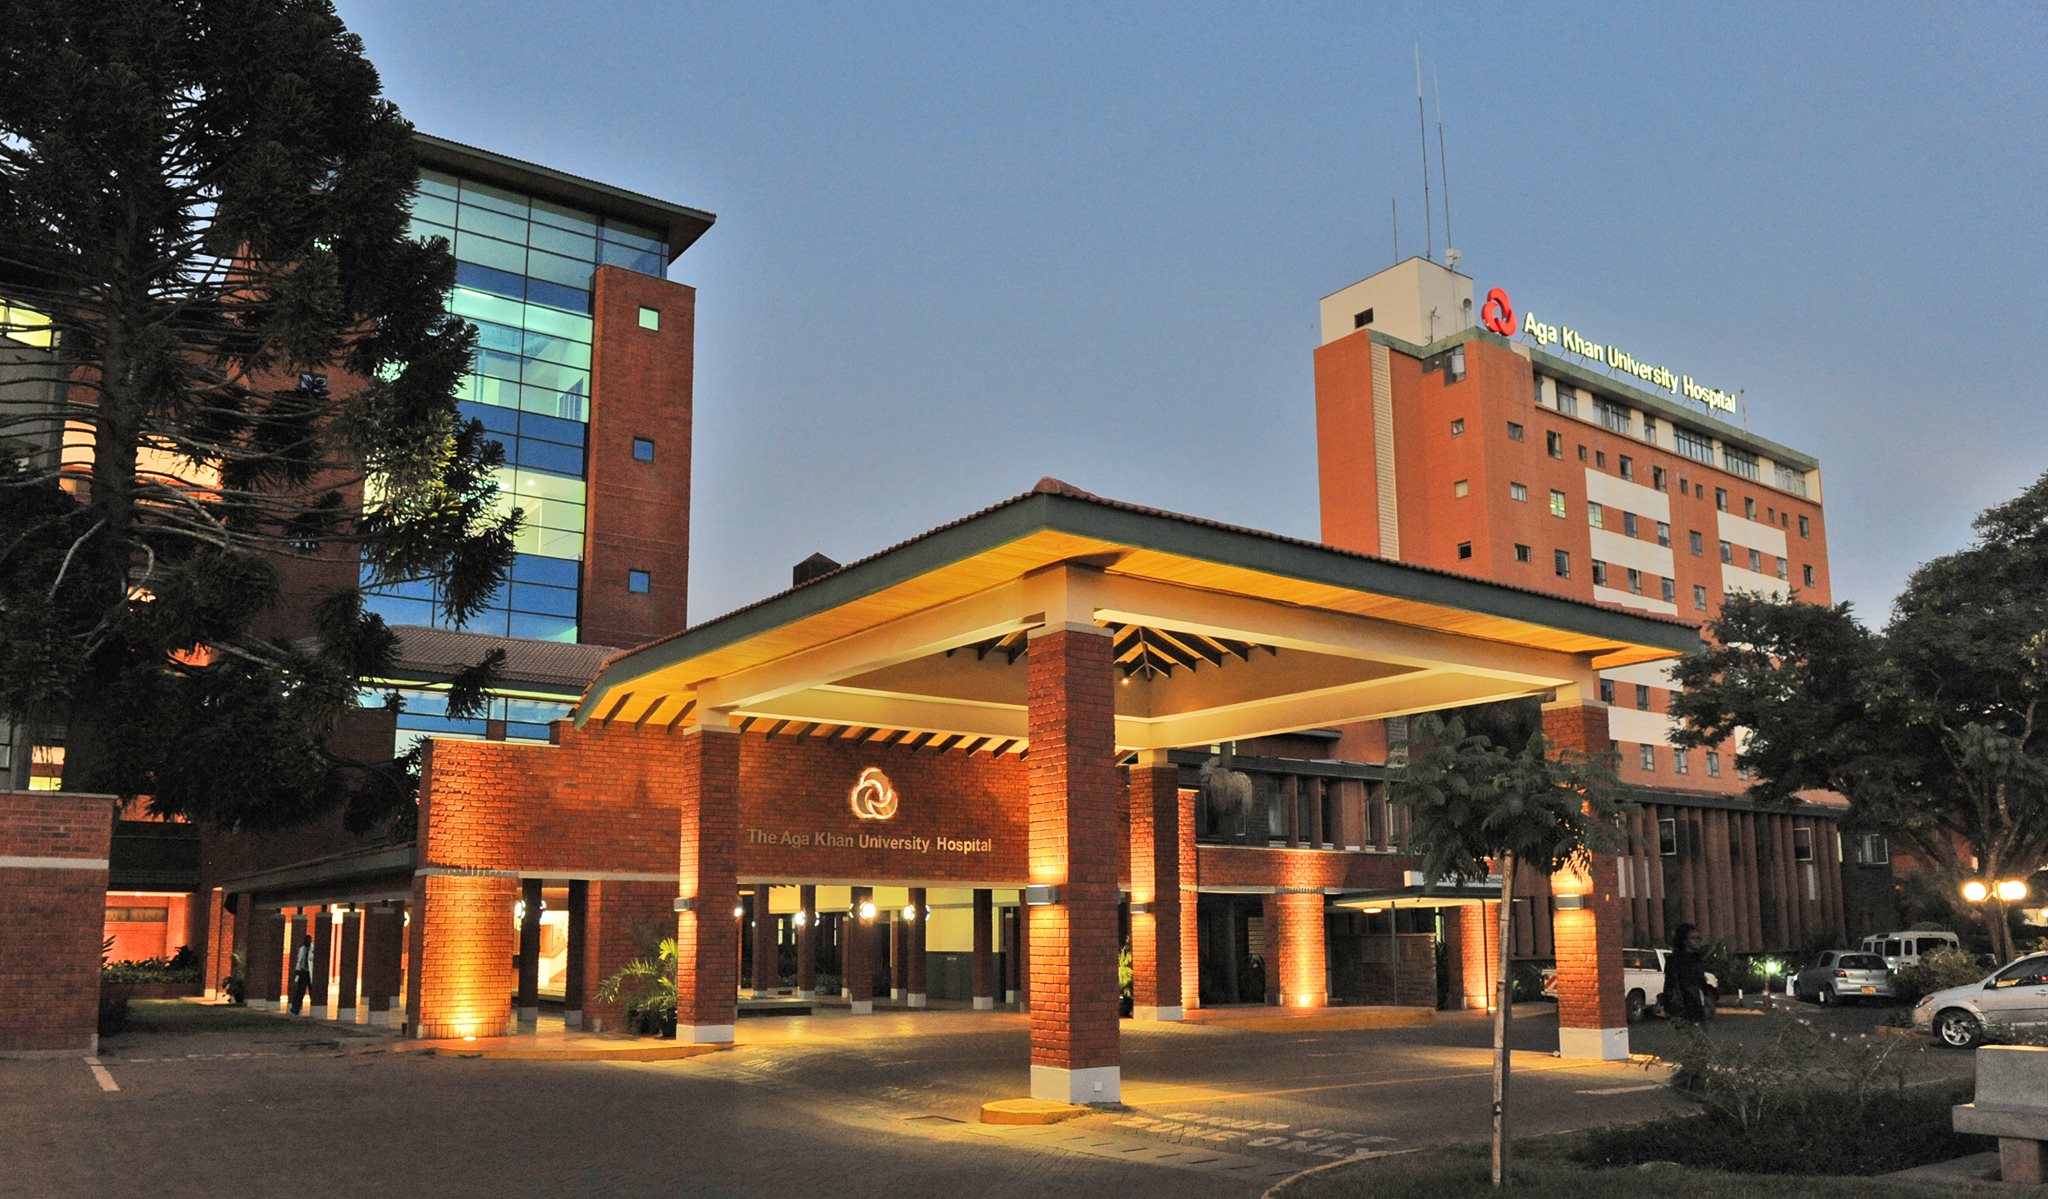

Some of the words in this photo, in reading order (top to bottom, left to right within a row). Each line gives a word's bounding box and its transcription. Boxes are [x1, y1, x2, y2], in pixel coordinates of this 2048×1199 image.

[1524, 312, 1557, 345] Aga
[1561, 327, 1603, 362] Khan
[1607, 345, 1678, 394] University
[1682, 375, 1736, 413] Hospital
[747, 829, 777, 844] The
[781, 831, 809, 848] Aga
[815, 832, 853, 847] Khan
[859, 835, 930, 854] University
[937, 837, 992, 854] Hospital
